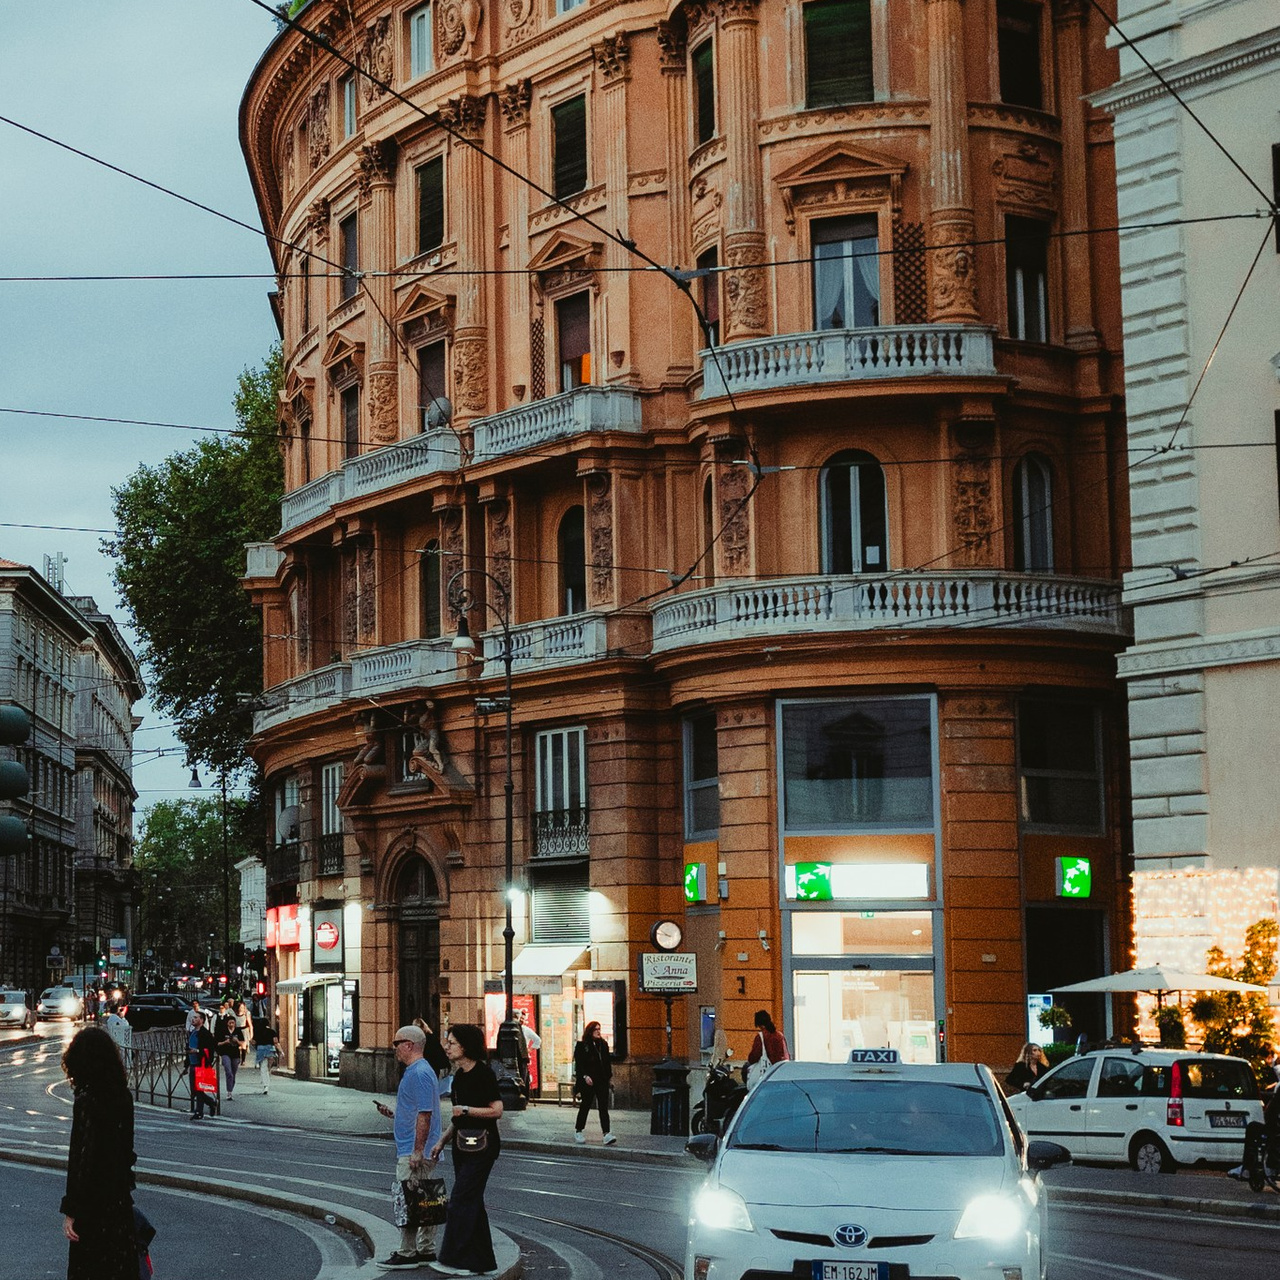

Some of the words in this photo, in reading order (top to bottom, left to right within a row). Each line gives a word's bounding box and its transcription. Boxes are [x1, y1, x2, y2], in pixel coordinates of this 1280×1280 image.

[644, 955, 694, 965] Ristorante
[662, 965, 689, 975] Anna
[853, 1051, 894, 1062] TAXI
